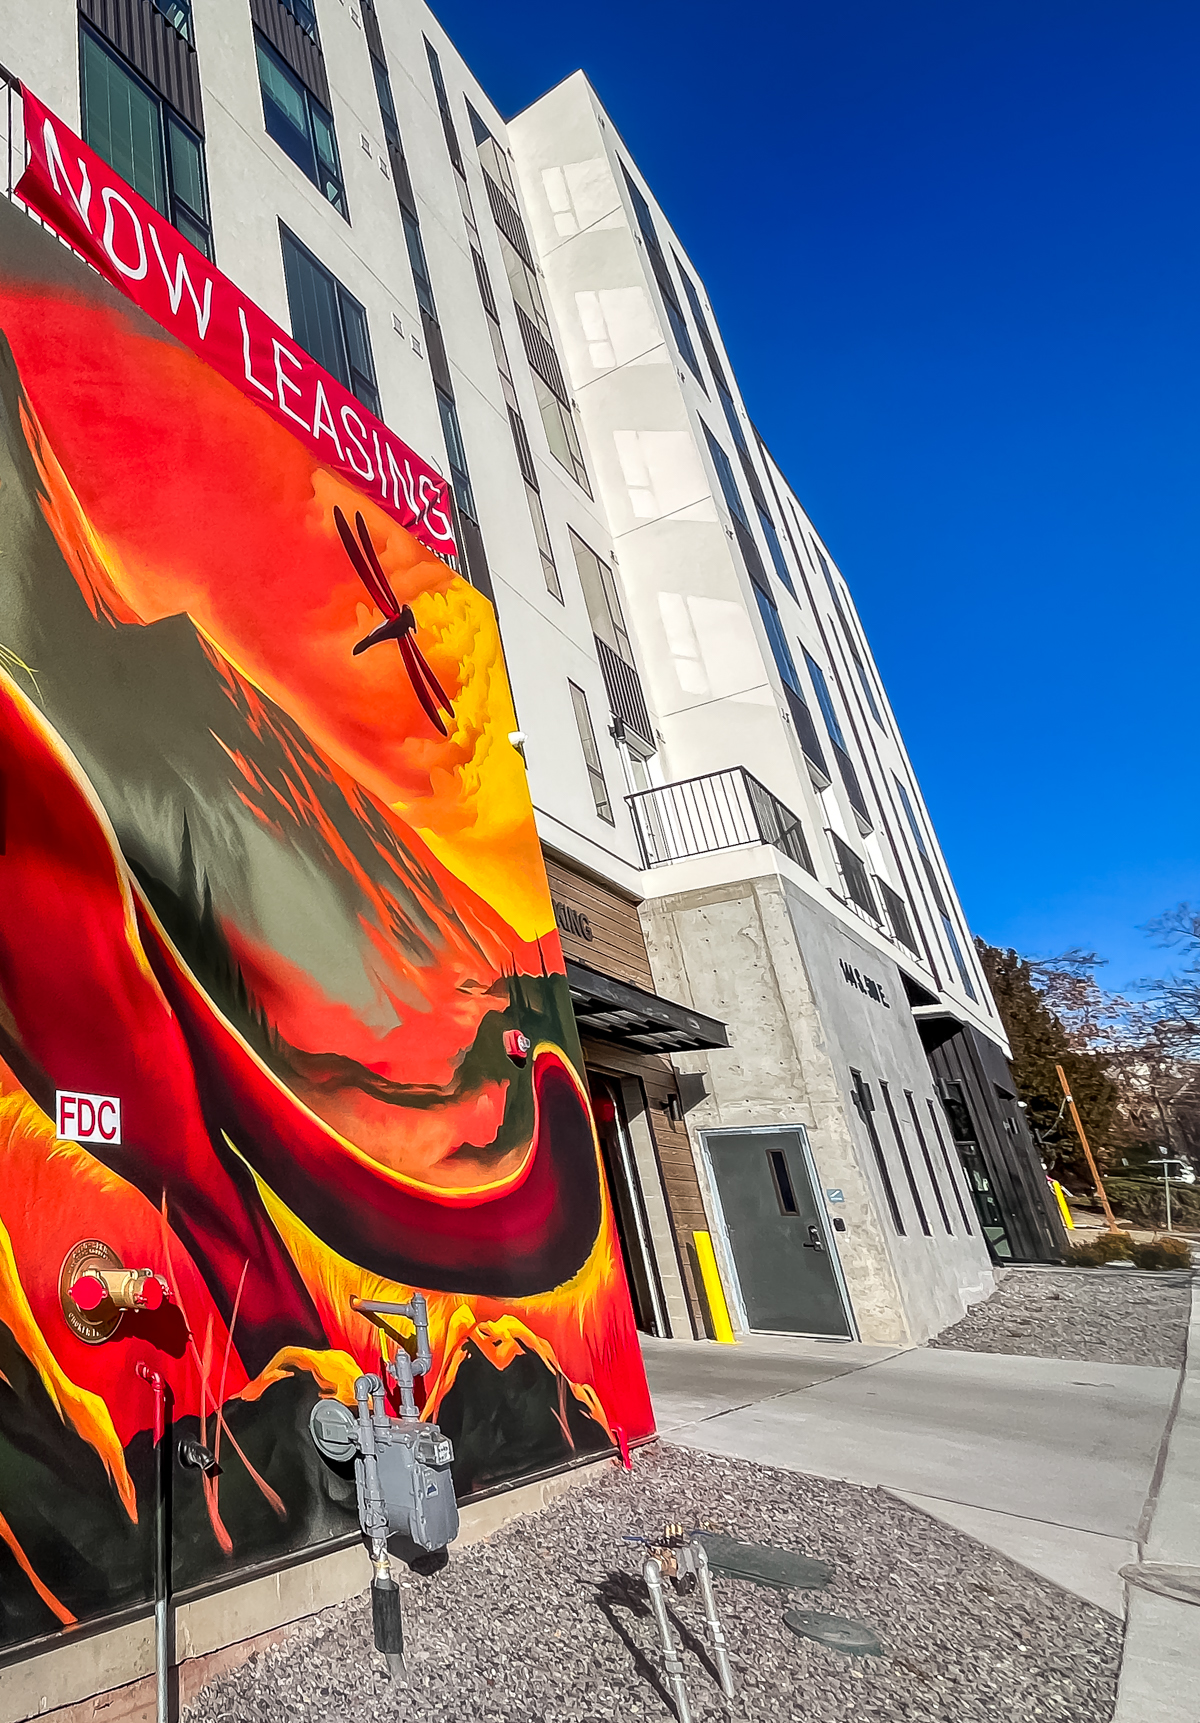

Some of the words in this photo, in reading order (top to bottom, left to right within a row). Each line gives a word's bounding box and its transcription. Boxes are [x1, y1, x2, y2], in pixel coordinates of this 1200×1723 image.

[43, 118, 213, 341] NOW
[238, 307, 453, 541] LEASING
[60, 1096, 117, 1140] FDC
